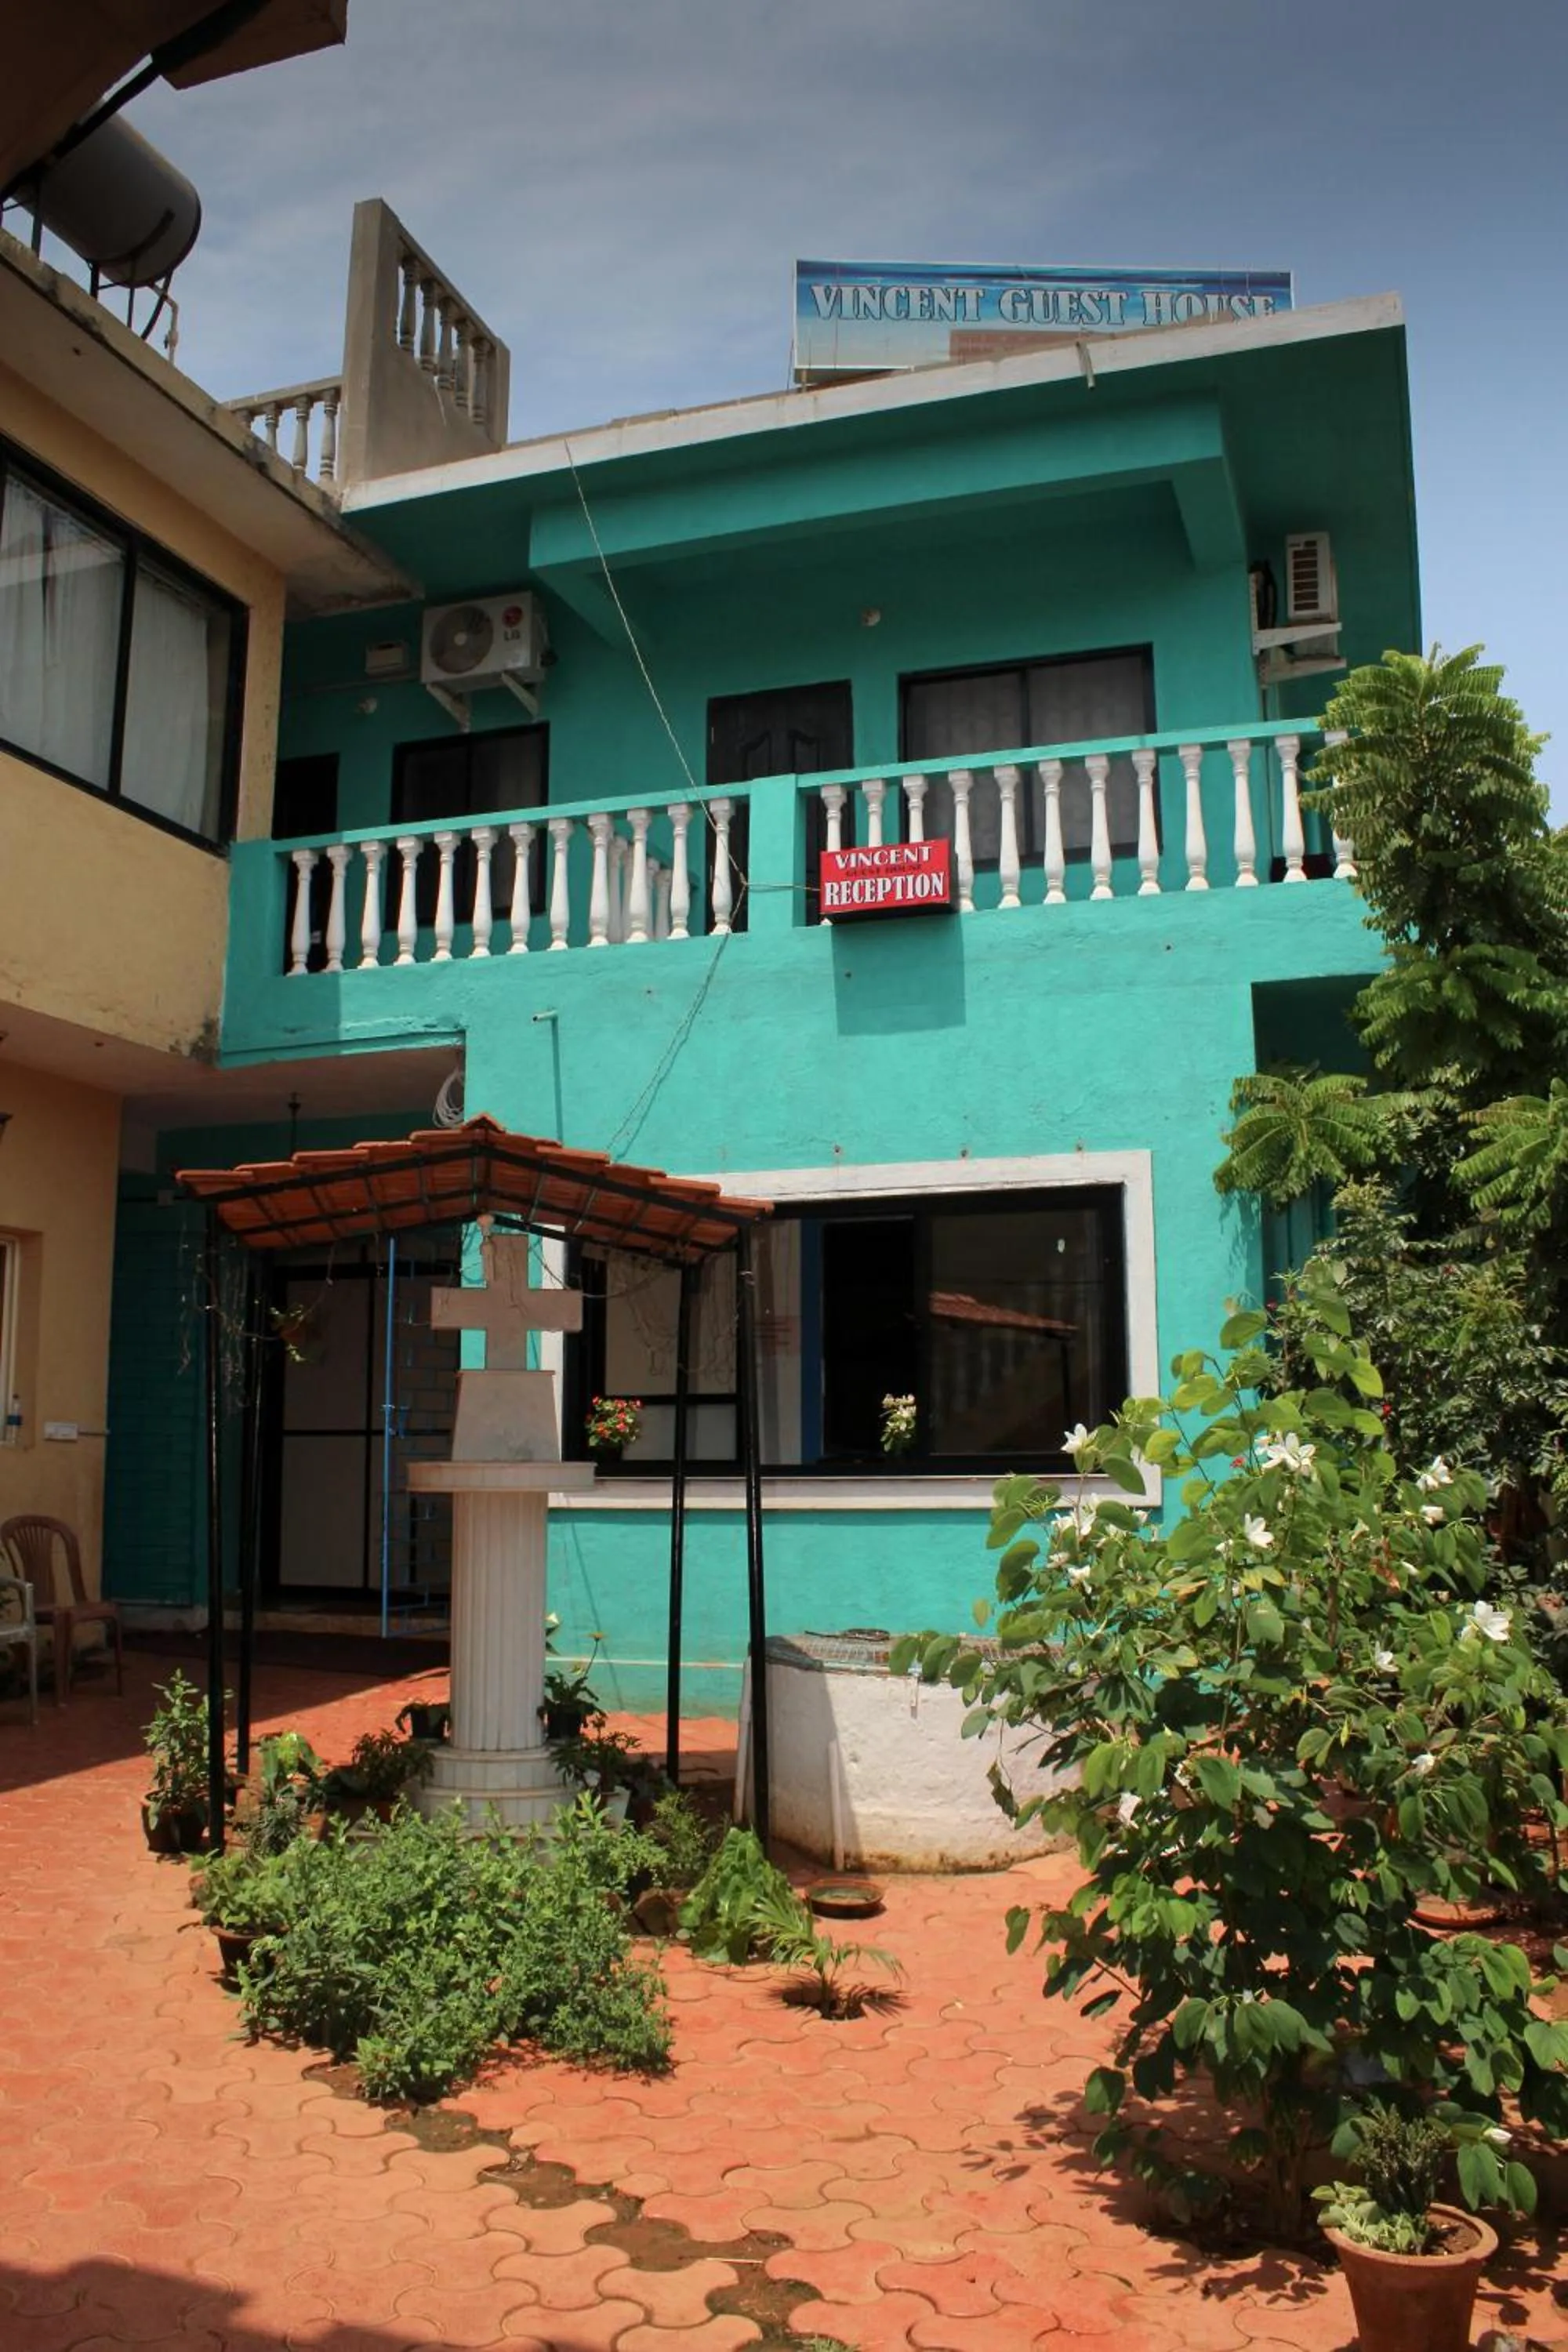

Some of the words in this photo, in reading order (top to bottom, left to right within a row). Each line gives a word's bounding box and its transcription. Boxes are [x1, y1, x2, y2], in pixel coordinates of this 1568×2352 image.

[811, 285, 985, 322] VINCENT
[999, 287, 1128, 325] GUEST
[1142, 290, 1276, 326] HOUSE
[835, 846, 932, 869] VINCENT
[824, 872, 945, 906] RECEPTION
